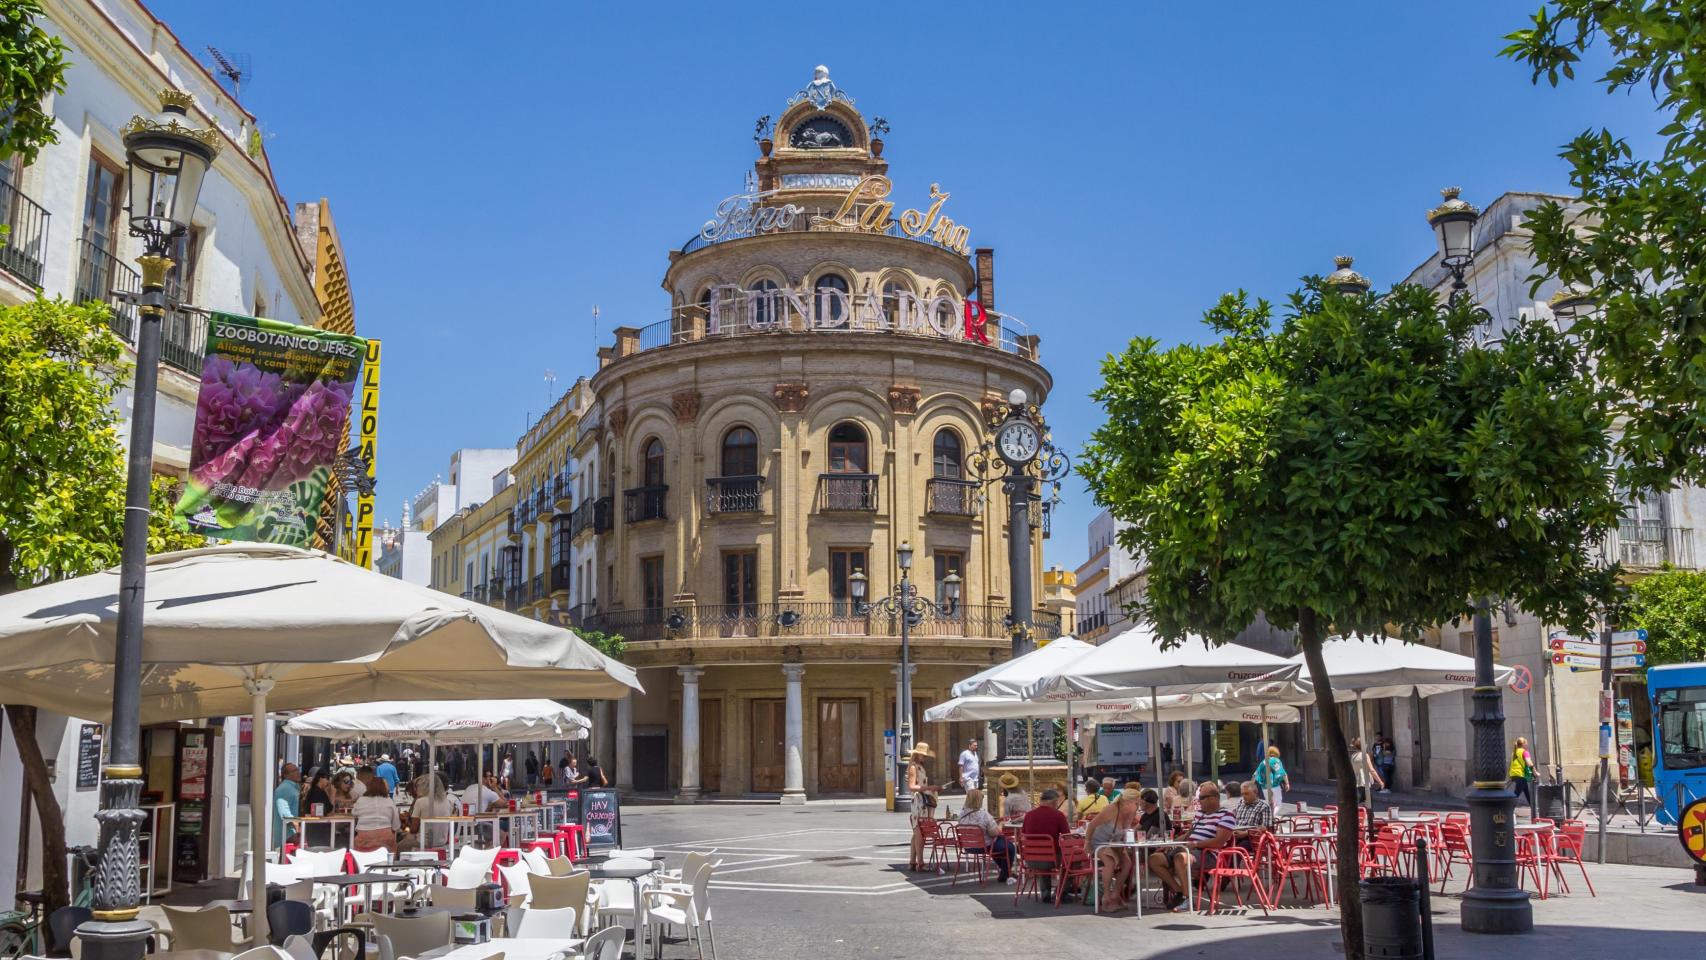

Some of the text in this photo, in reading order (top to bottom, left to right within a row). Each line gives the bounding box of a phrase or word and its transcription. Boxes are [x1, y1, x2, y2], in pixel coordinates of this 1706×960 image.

[701, 174, 971, 256] Fino La Ina
[708, 284, 992, 347] FUNDADOR
[217, 342, 256, 355] Aliados
[264, 359, 302, 370] cambio
[321, 341, 358, 358] JEREZ
[362, 343, 380, 460] ULLOA
[358, 479, 374, 567] PTI
[591, 800, 608, 811] HAY
